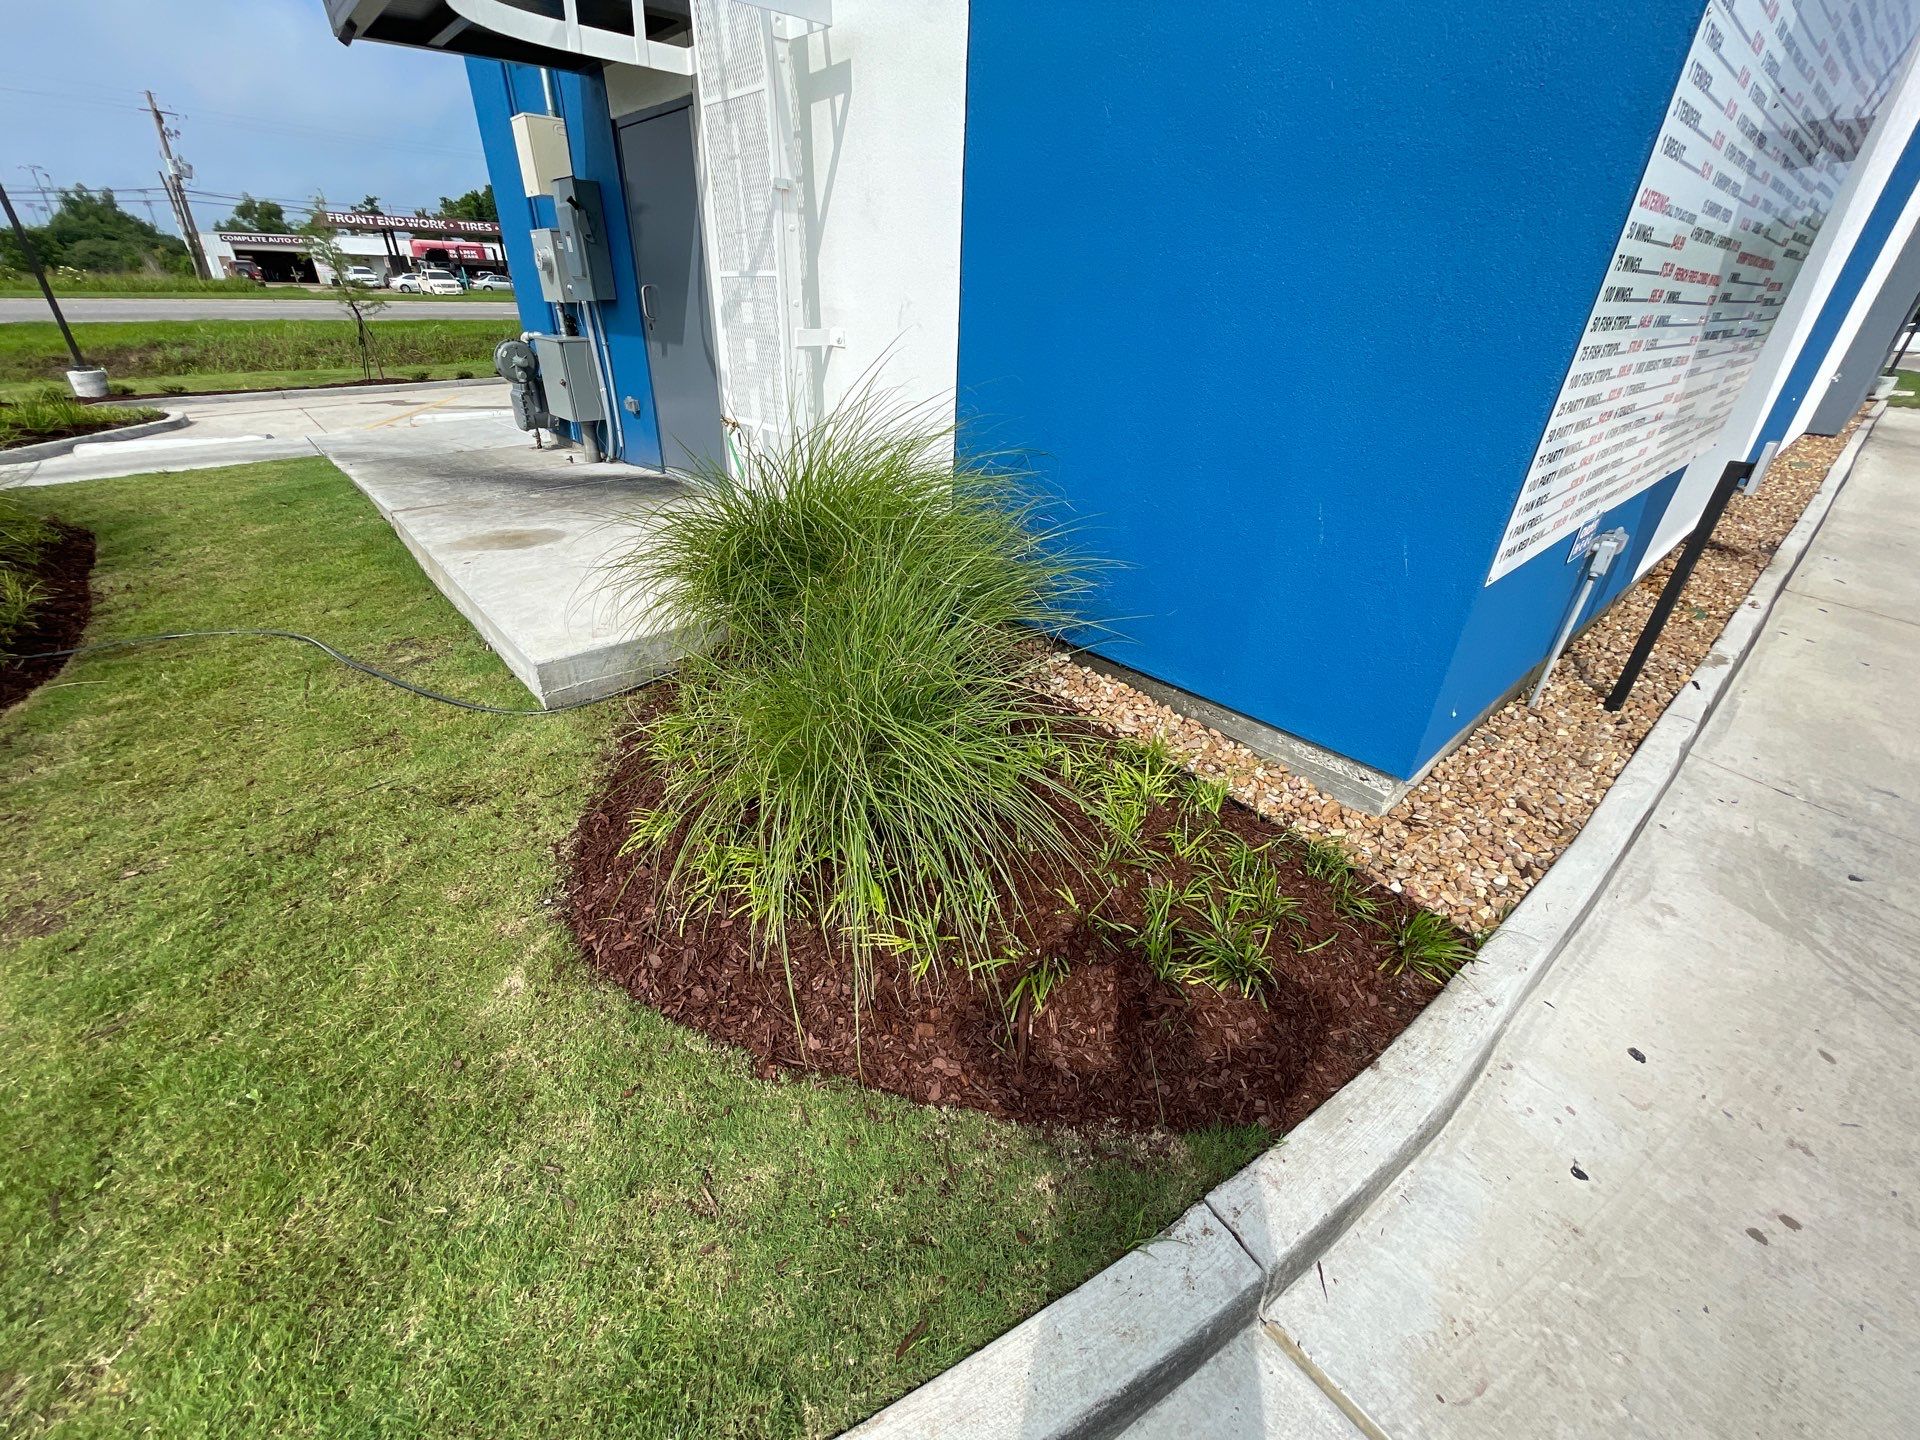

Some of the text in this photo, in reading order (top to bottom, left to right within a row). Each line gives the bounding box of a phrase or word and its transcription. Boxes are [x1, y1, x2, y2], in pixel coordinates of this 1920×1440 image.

[1707, 24, 1725, 53] THIGH
[1691, 63, 1714, 95] TENDER
[1677, 101, 1703, 131] TENDERS
[1664, 137, 1687, 163] BREAST
[1639, 188, 1670, 215] CATERING
[326, 212, 447, 230] FRONT END WORK
[458, 221, 492, 232] TIRES
[221, 235, 267, 243] COMPLETE
[1627, 223, 1638, 239] 50
[1635, 225, 1655, 243] WINGS
[1615, 255, 1626, 271] 75
[1622, 257, 1643, 273] WINGS
[1602, 287, 1617, 302] 100
[1613, 288, 1634, 302] WINGS
[1591, 318, 1602, 332] 50
[1599, 317, 1615, 332] FISH
[1612, 316, 1632, 331] STRIPS
[1579, 347, 1590, 361] 75
[1588, 345, 1603, 360] FISH
[1601, 343, 1621, 358] STRIPS
[1568, 374, 1582, 390] 100
[1580, 371, 1595, 387] FISH
[1593, 368, 1613, 384] STRIPS
[1557, 402, 1568, 417] 25
[1565, 397, 1586, 414] PARTY
[1584, 393, 1603, 409] WINGS
[1546, 429, 1558, 444] 50
[1555, 423, 1575, 440] PARTY
[1574, 417, 1593, 434] WINGS
[1537, 455, 1547, 469] 75
[1545, 448, 1565, 465] PARTY
[1527, 478, 1540, 494] 100
[1538, 470, 1558, 488] PARTY
[1522, 499, 1537, 515] PAN
[1535, 492, 1550, 508] RICE
[1513, 521, 1528, 538] PAN
[1526, 513, 1544, 531] FRIES
[1504, 544, 1518, 561] PAN
[1517, 537, 1531, 553] RED
